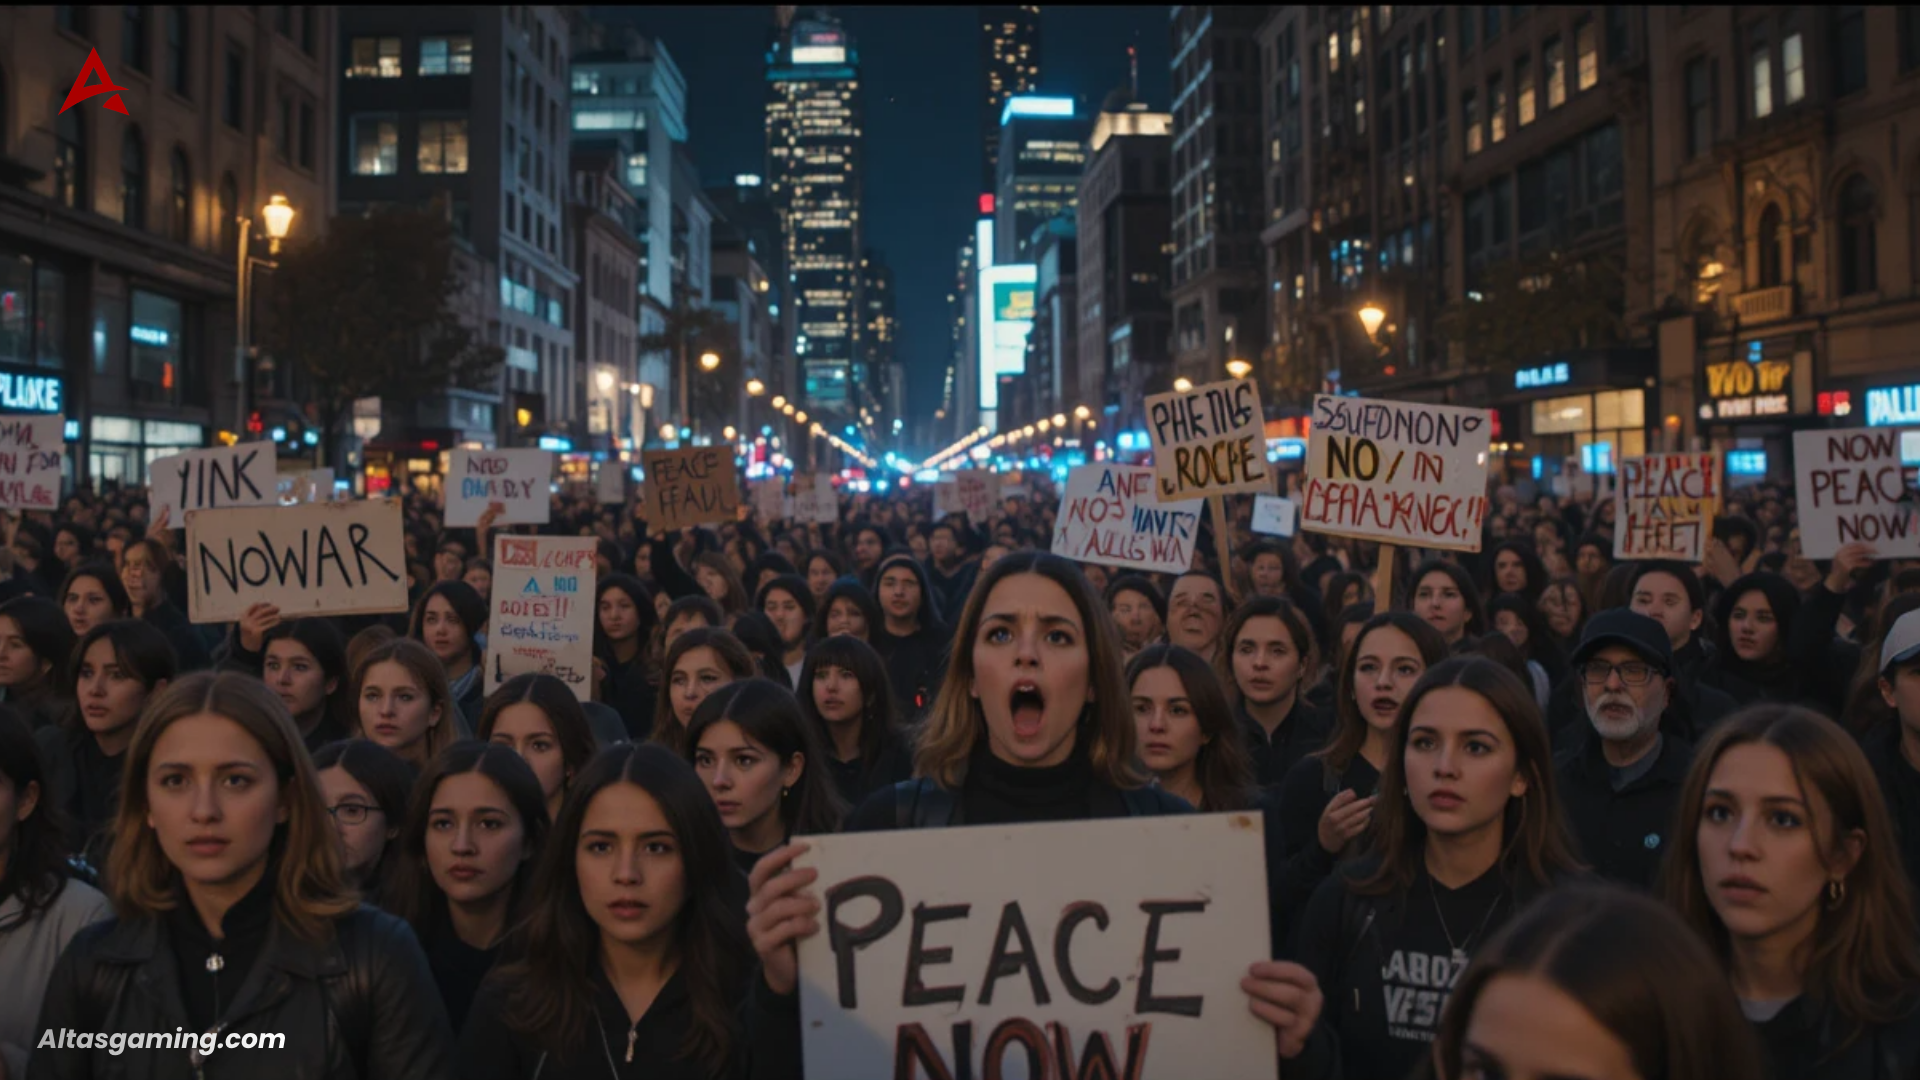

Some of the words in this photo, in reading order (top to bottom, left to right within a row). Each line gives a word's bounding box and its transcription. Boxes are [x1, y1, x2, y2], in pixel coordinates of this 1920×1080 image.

[1327, 435, 1380, 481] NO
[1827, 431, 1896, 462] NOW
[825, 875, 1210, 1017] PEACE
[894, 1016, 1152, 1080] NOW
